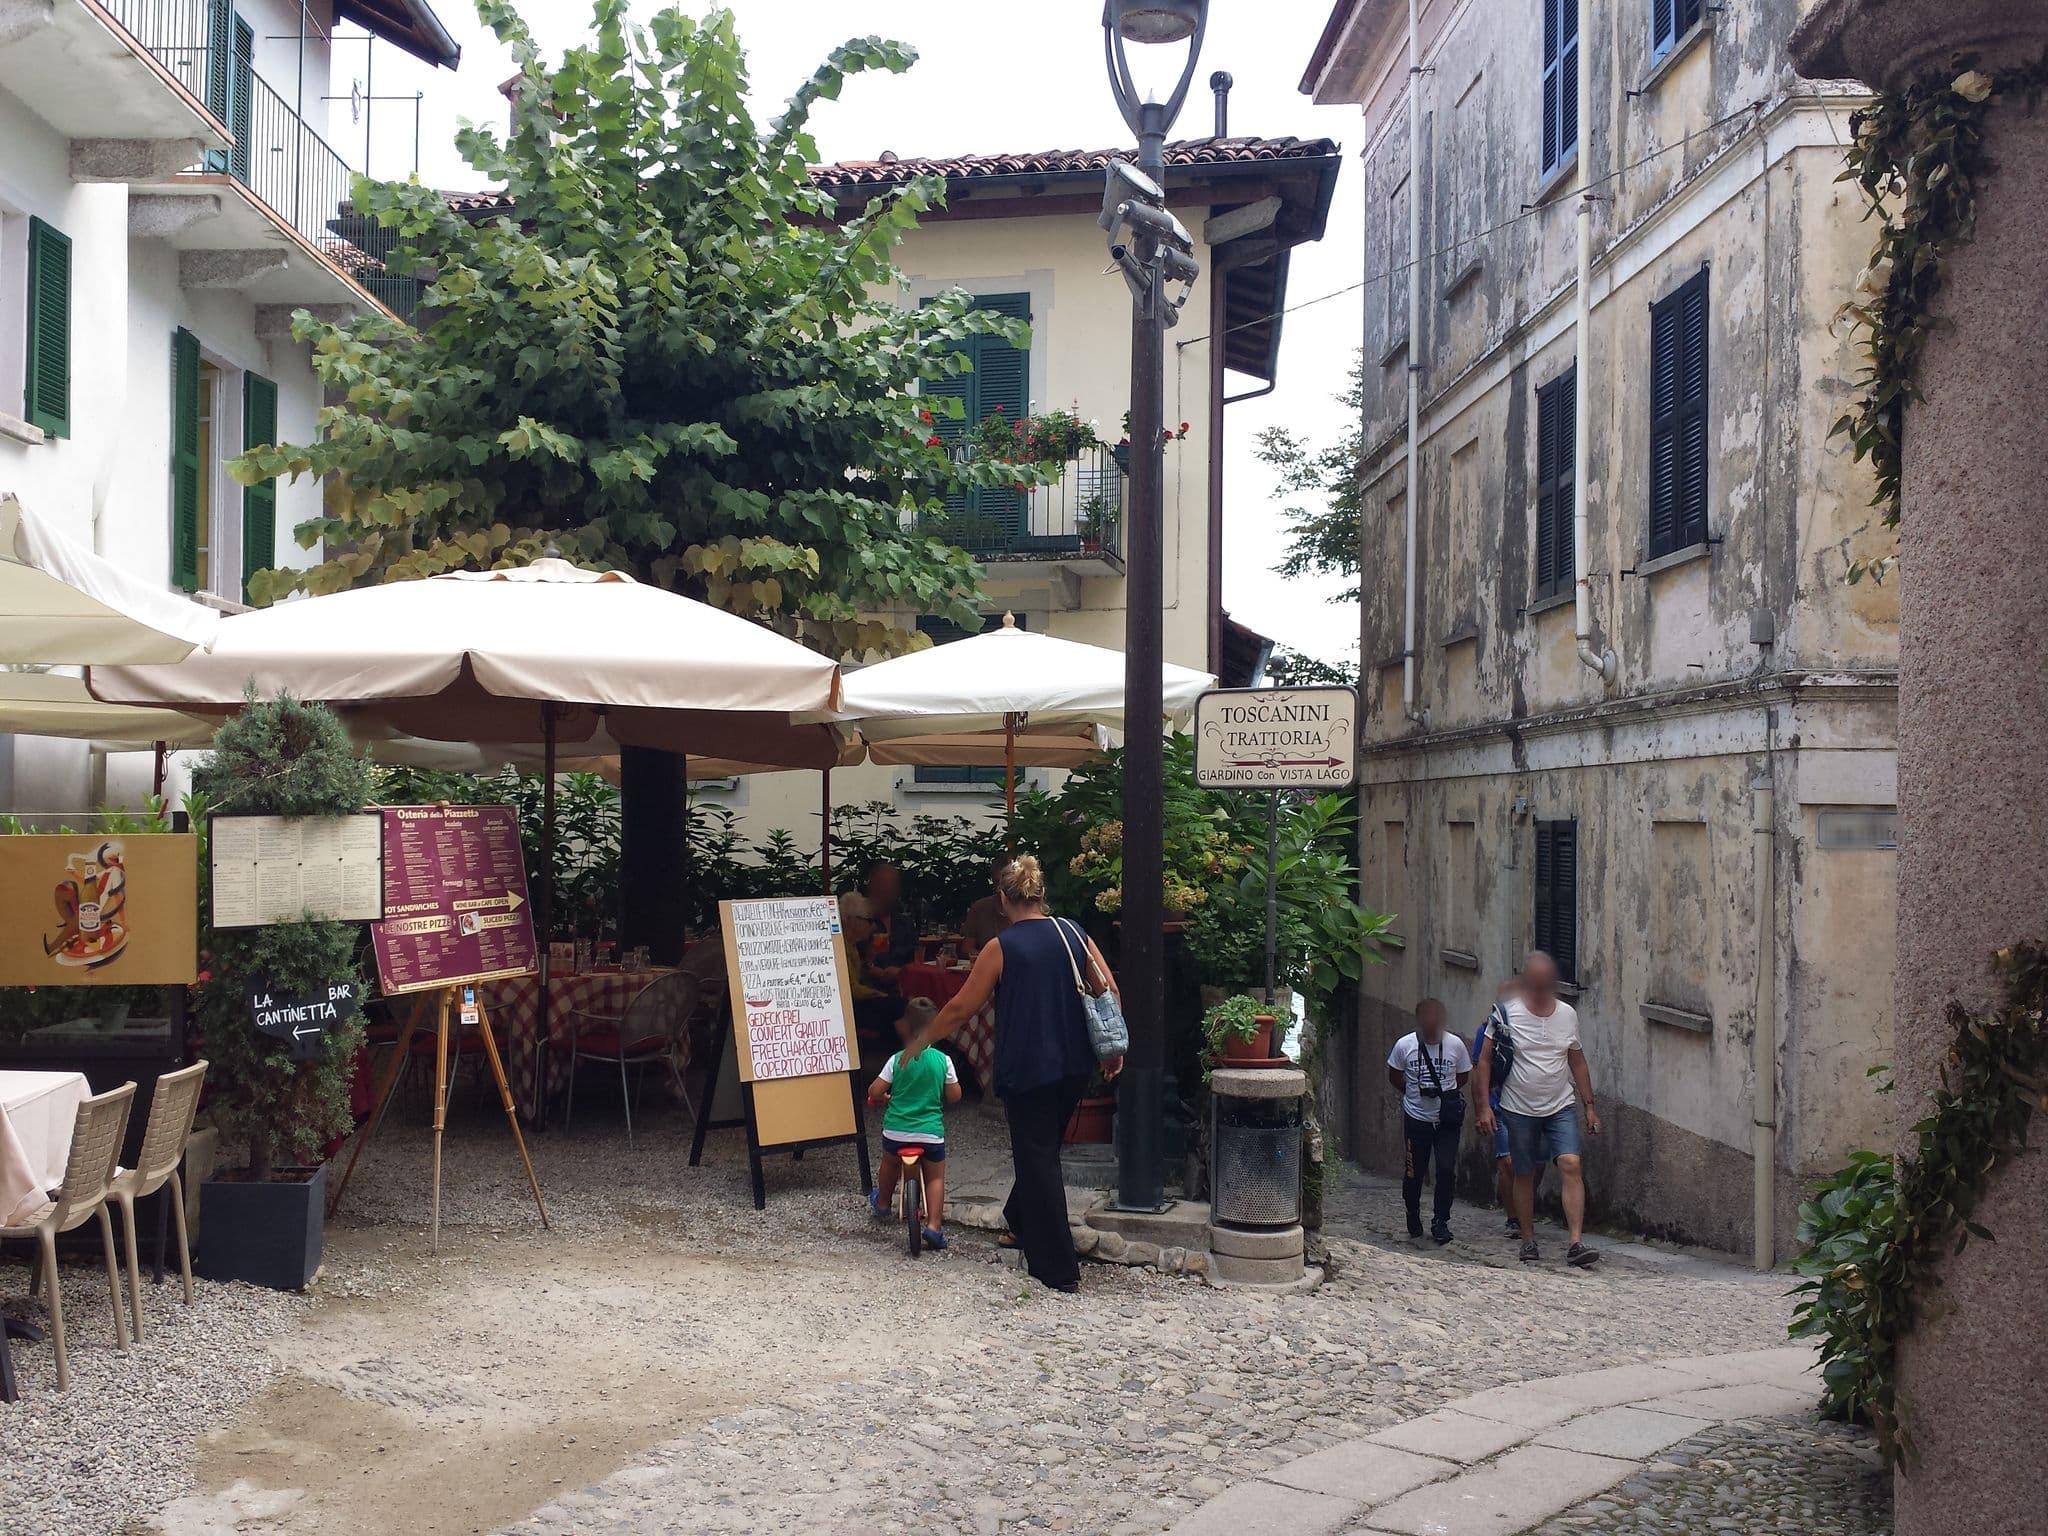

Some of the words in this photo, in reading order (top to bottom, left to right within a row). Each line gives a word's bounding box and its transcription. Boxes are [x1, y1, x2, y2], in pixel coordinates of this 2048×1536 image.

[1220, 704, 1331, 723] TOSCANINI
[1227, 731, 1323, 746] TRATTORIA
[1198, 769, 1254, 781] GIARDINO
[1280, 769, 1313, 780] VISTA
[1317, 768, 1350, 780] LAGO
[397, 809, 429, 819] Osteria
[443, 808, 479, 818] Piazzetta
[397, 902, 439, 913] SANDWICHES
[396, 920, 428, 931] NOSTRE
[429, 918, 452, 928] PIZZE
[328, 984, 352, 1000] BAR
[254, 994, 273, 1008] LA
[748, 1011, 782, 1027] GEDECK
[782, 1009, 800, 1024] FREI
[750, 1024, 792, 1042] COUVERT
[795, 1019, 830, 1039] GRATUIT
[752, 1042, 780, 1061] FREE
[780, 1038, 818, 1058] CHARGE
[818, 1036, 847, 1055] COVER
[754, 1058, 803, 1079] COPERTO
[804, 1053, 844, 1073] GRATIS
